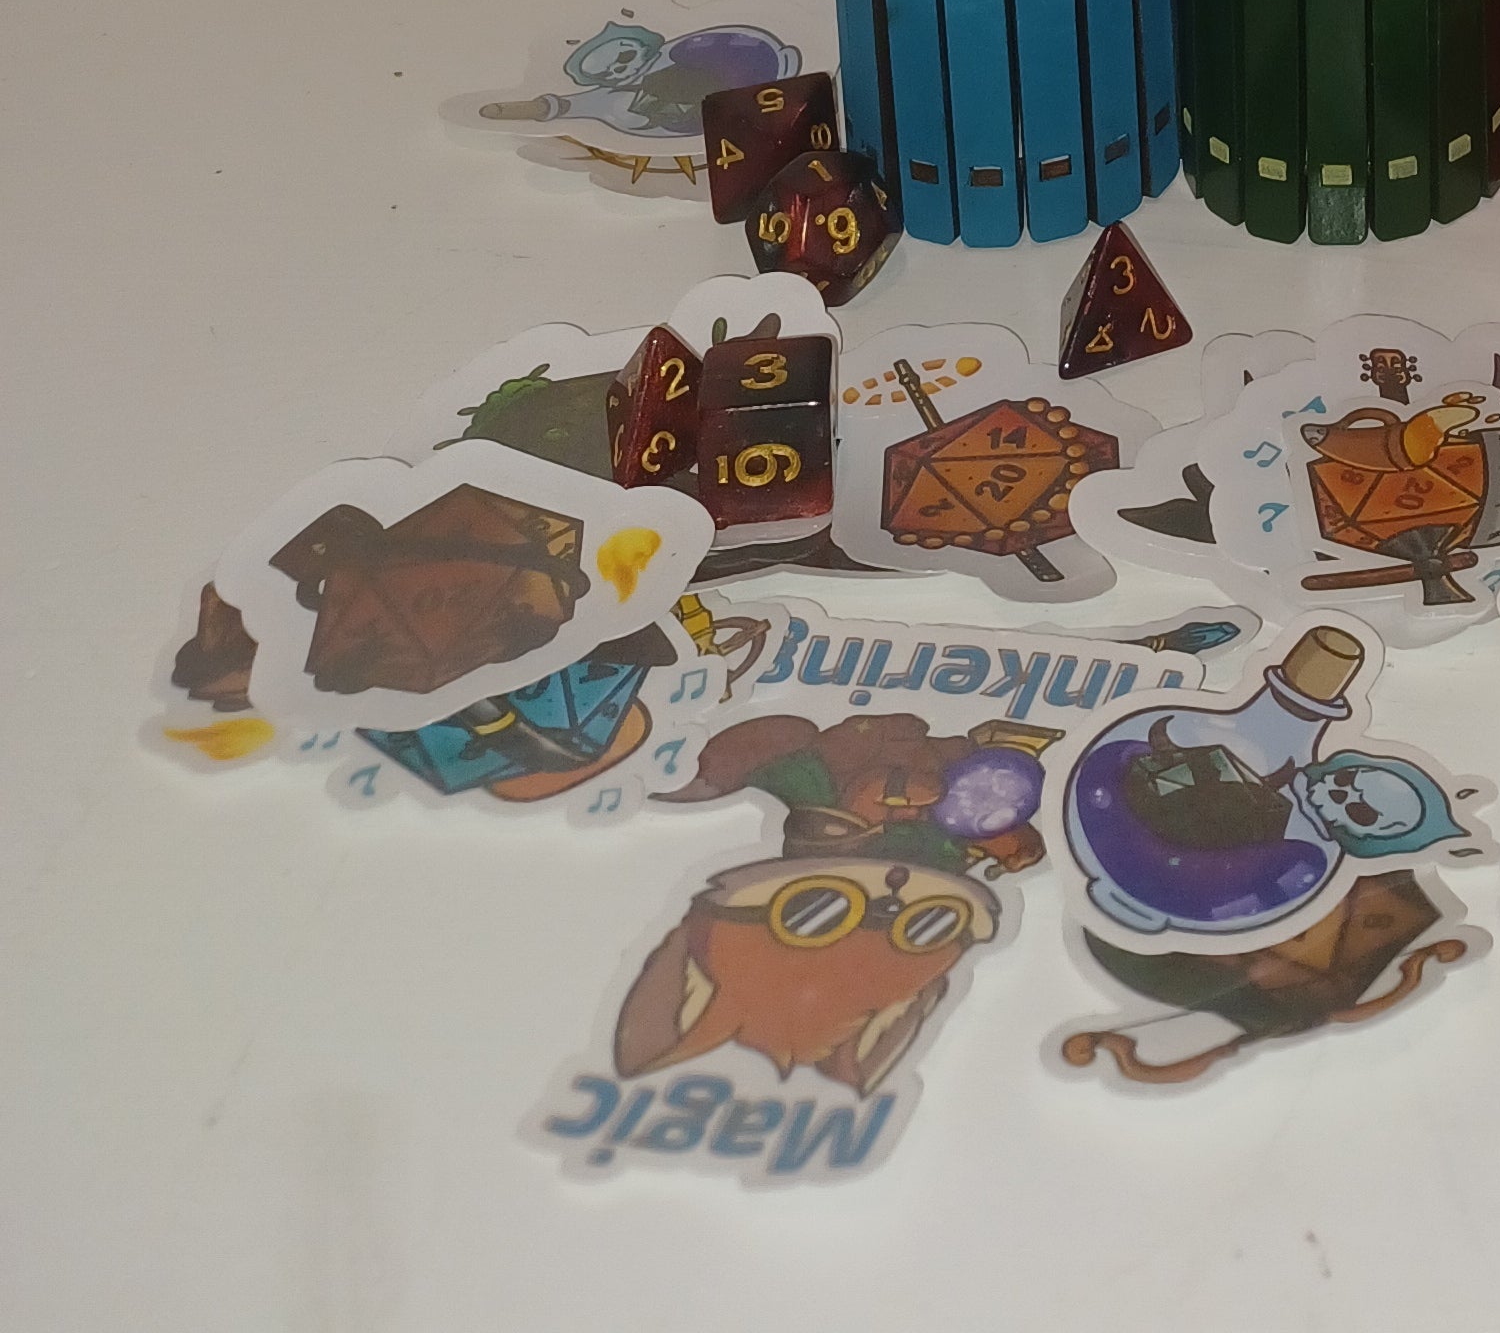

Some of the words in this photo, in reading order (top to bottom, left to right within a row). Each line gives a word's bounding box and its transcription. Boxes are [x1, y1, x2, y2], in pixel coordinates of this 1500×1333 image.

[1110, 255, 1135, 295] 3
[660, 358, 690, 402] 2
[741, 353, 788, 390] 3
[642, 431, 676, 473] 3
[974, 463, 1027, 502] 20
[544, 1074, 896, 1176] Magic
